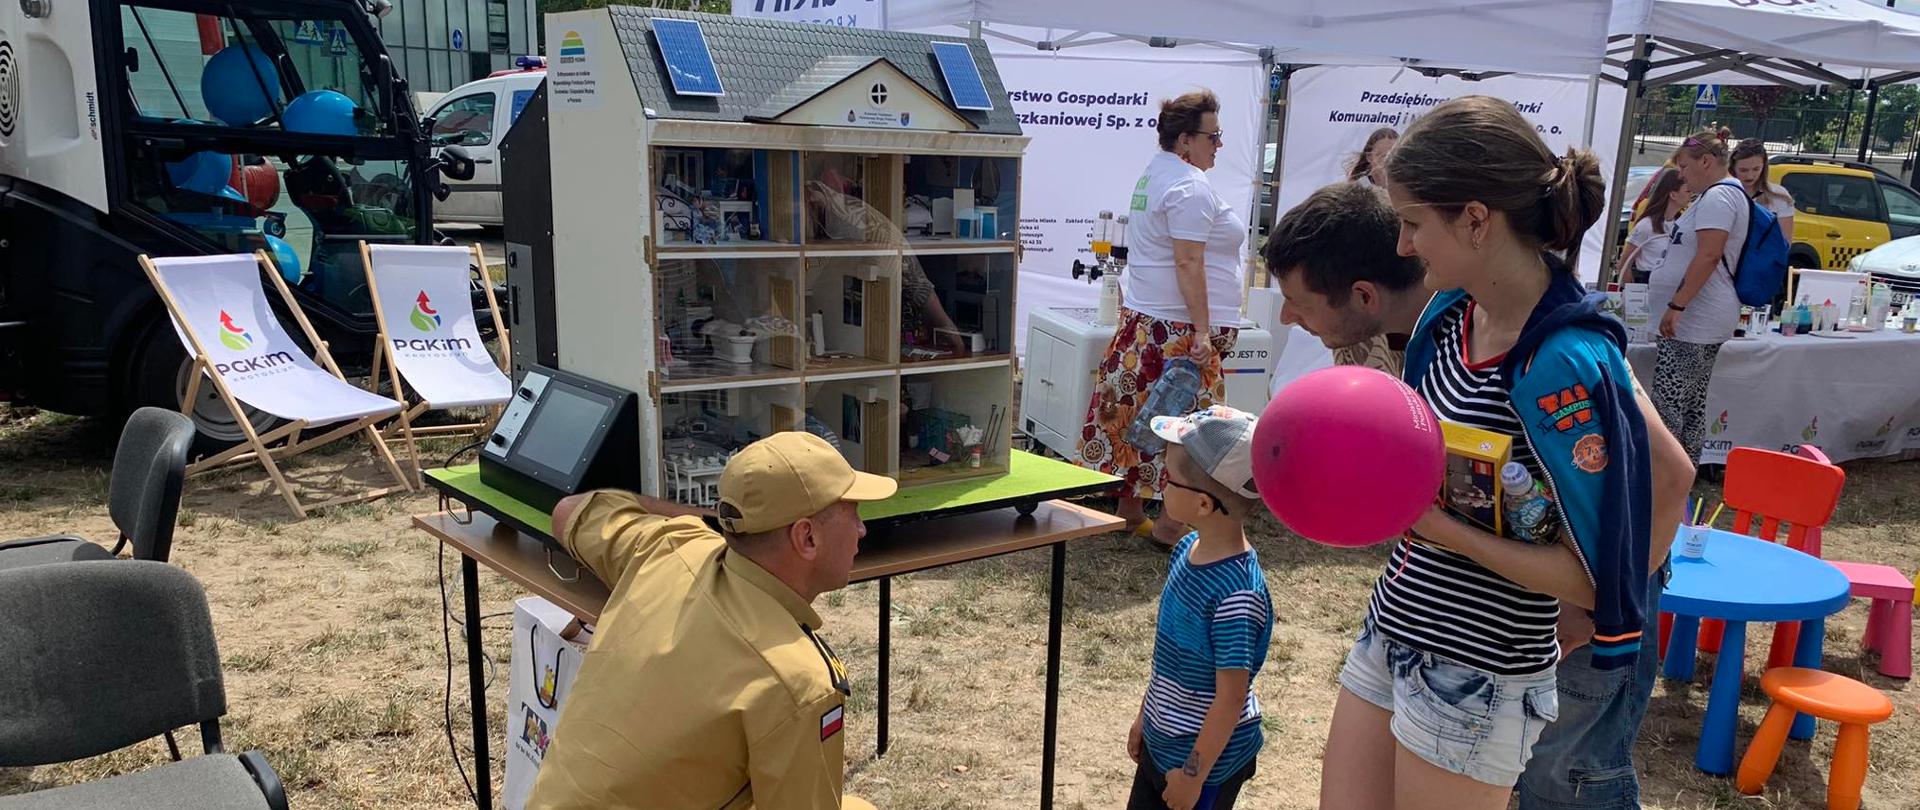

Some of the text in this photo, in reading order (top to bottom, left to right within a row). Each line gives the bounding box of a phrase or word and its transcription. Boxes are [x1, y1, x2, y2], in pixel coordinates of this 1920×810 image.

[1007, 89, 1149, 107] rstwo Gospodarki
[86, 91, 97, 128] schmidt
[1015, 111, 1158, 130] szkaniowej Sp. z o
[1329, 110, 1402, 127] Komunalnej
[1550, 125, 1562, 135] o.
[1237, 350, 1254, 358] JEST
[1256, 350, 1268, 358] TO
